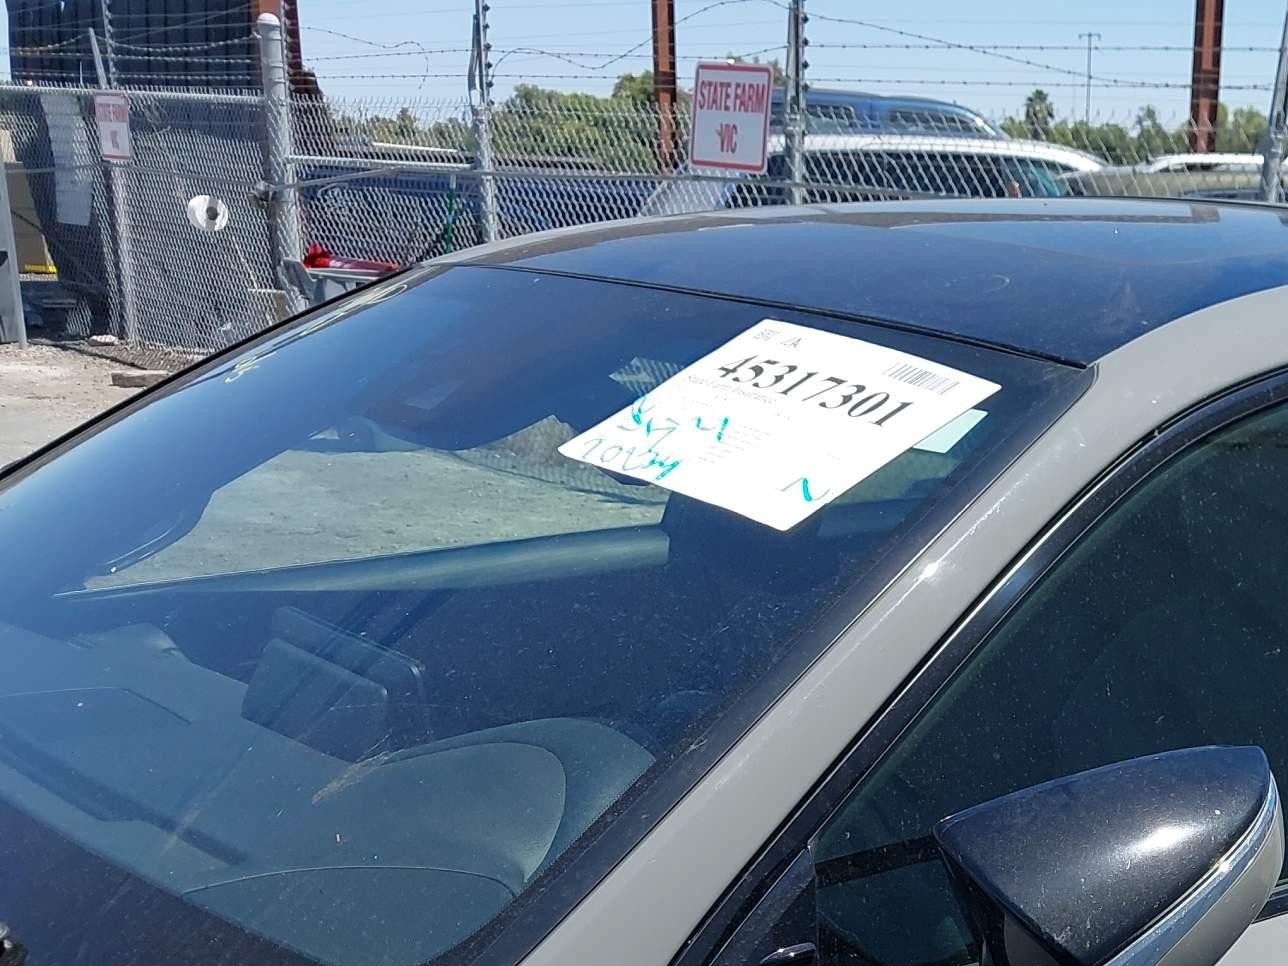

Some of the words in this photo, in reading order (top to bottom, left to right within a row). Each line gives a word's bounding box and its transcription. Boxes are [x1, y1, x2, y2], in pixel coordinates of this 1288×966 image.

[698, 80, 732, 111] STATE
[733, 82, 766, 113] FARM
[717, 354, 915, 428] 45317301
